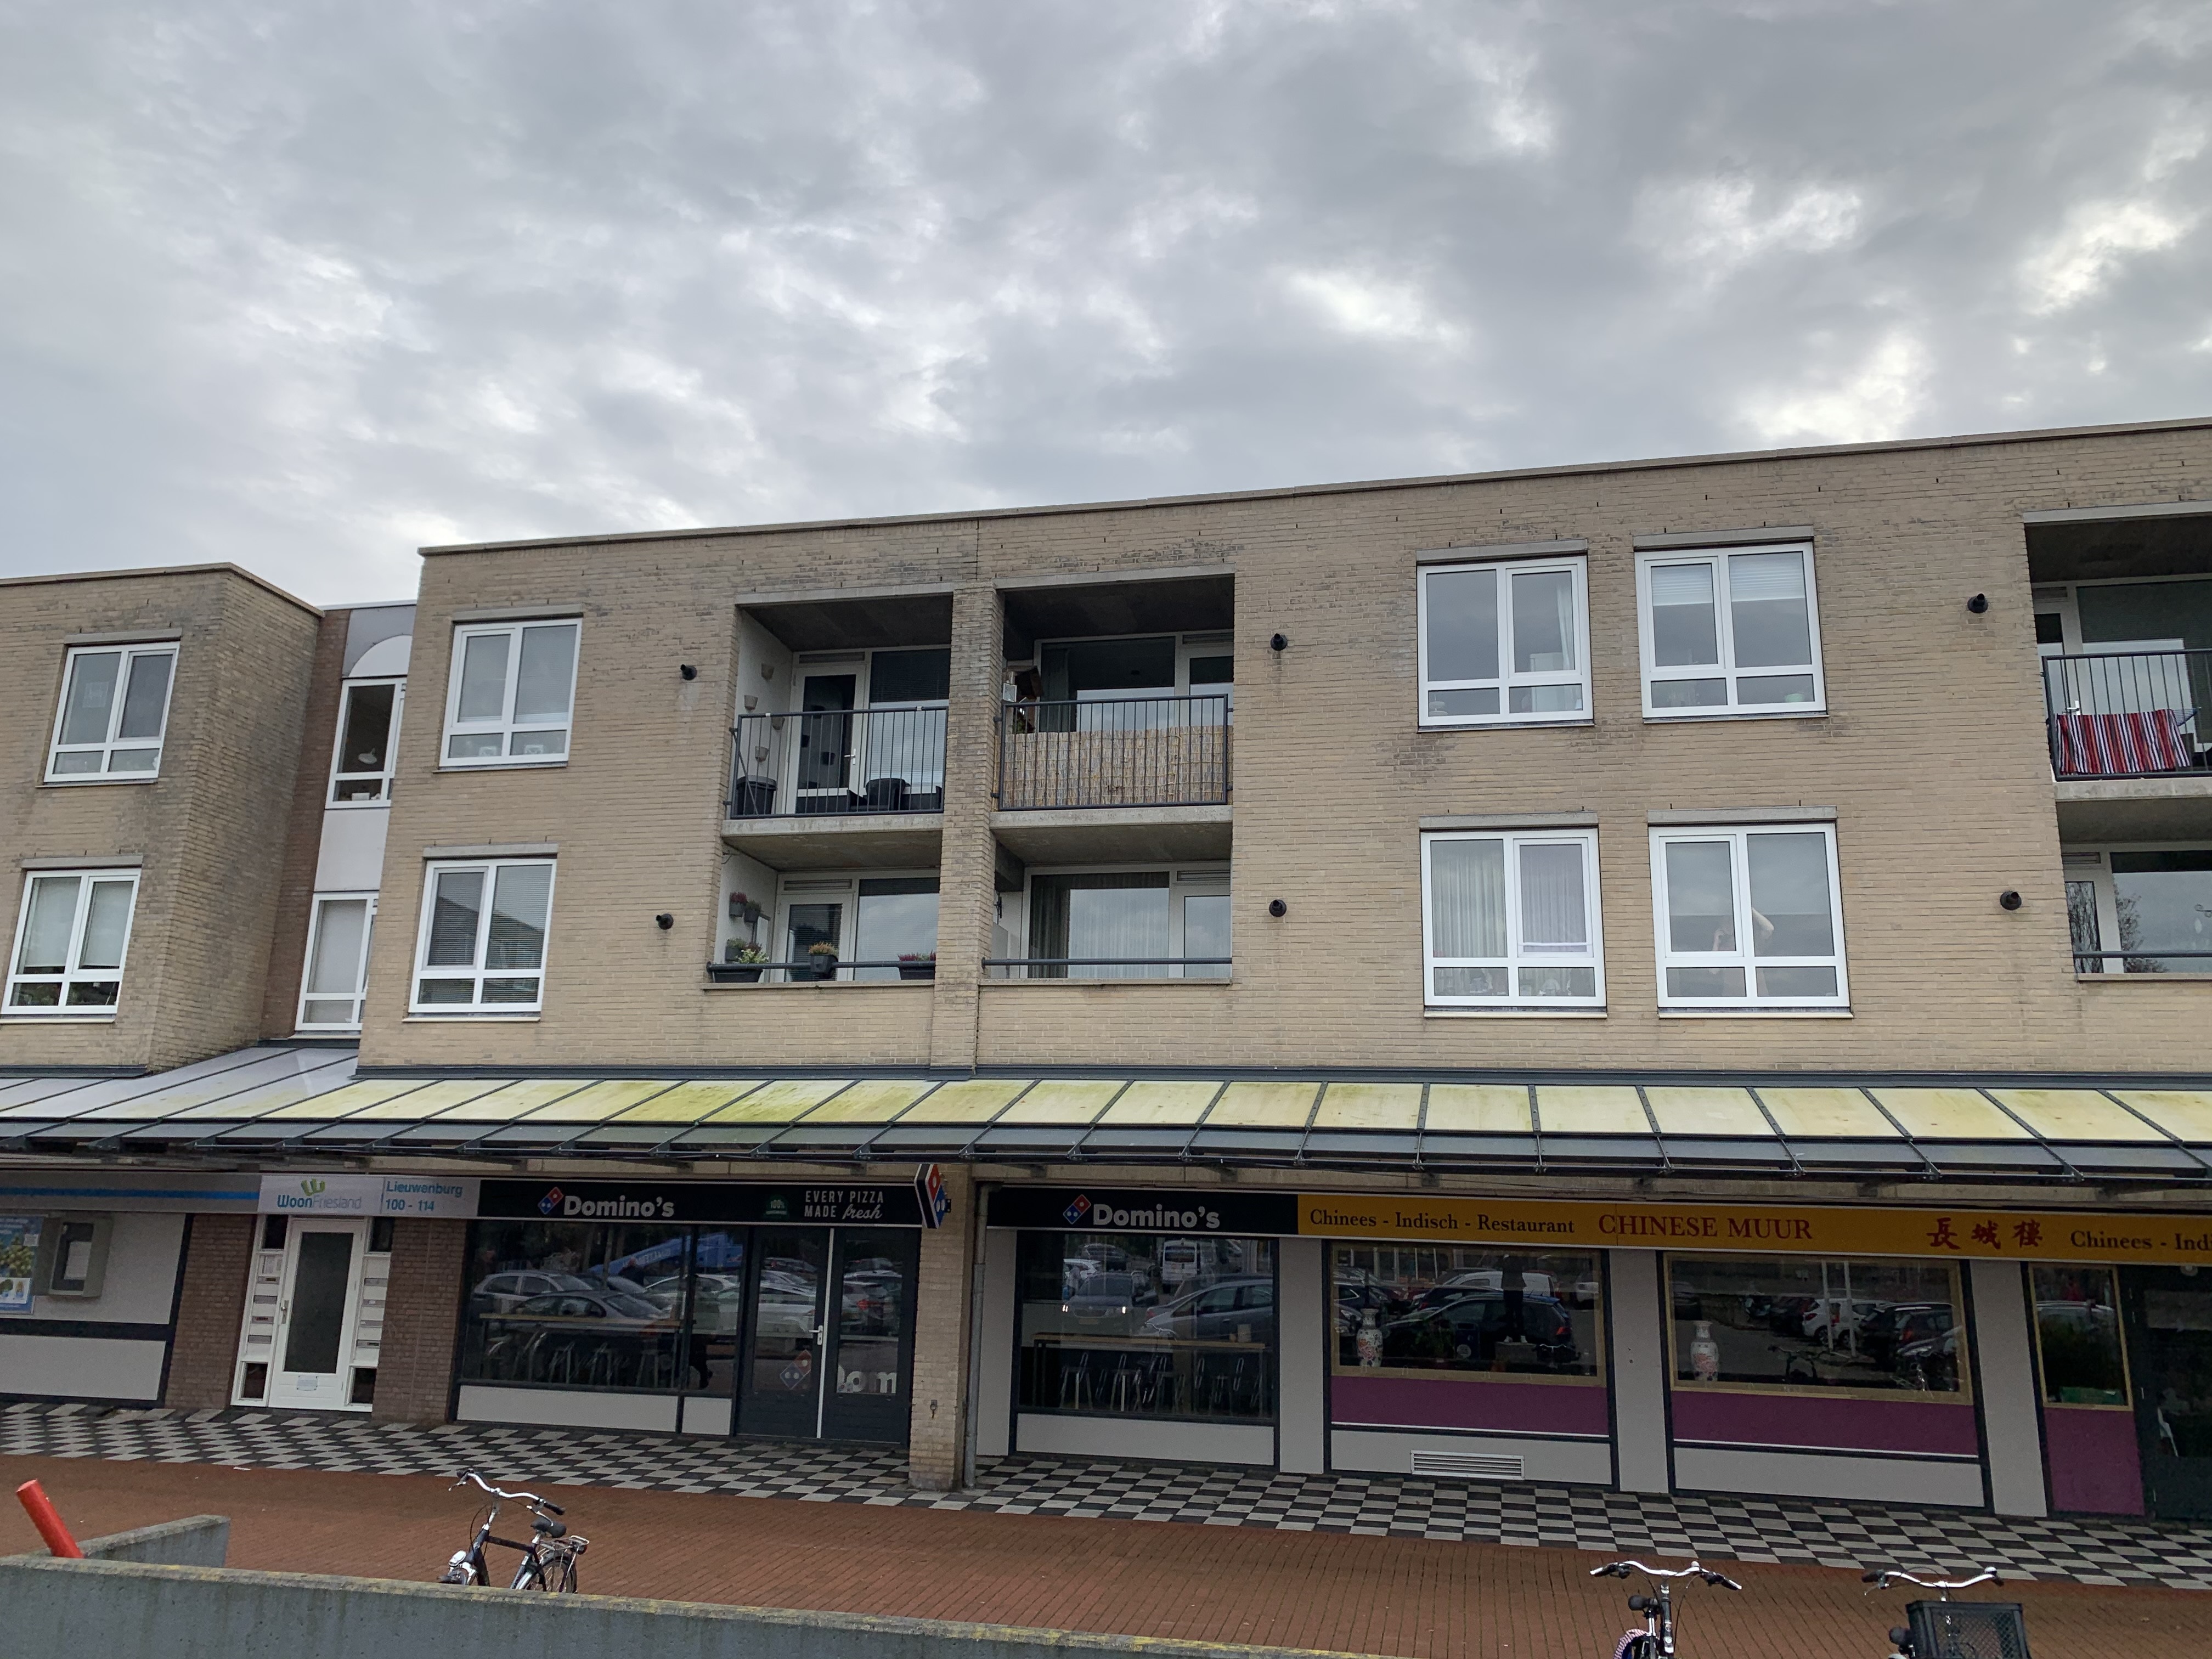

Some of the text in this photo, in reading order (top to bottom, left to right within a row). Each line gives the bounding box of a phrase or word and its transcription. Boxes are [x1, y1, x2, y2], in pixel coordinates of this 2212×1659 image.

[387, 1181, 464, 1198] Lieuwenburg
[805, 1190, 884, 1203] EVERY PIZZA
[277, 1194, 361, 1210] WoonFriesland
[386, 1199, 405, 1210] 100
[418, 1200, 435, 1211] 114
[563, 1195, 675, 1217] Domino's
[804, 1204, 883, 1220] MADE fresh
[1093, 1203, 1221, 1229] Domino's
[1310, 1209, 1376, 1227] Chinees
[1395, 1212, 1458, 1229] Indisch
[1477, 1214, 1576, 1233] Restaurant
[1598, 1214, 1813, 1239] CHINESE MUUR
[2070, 1231, 2152, 1250] Chinees
